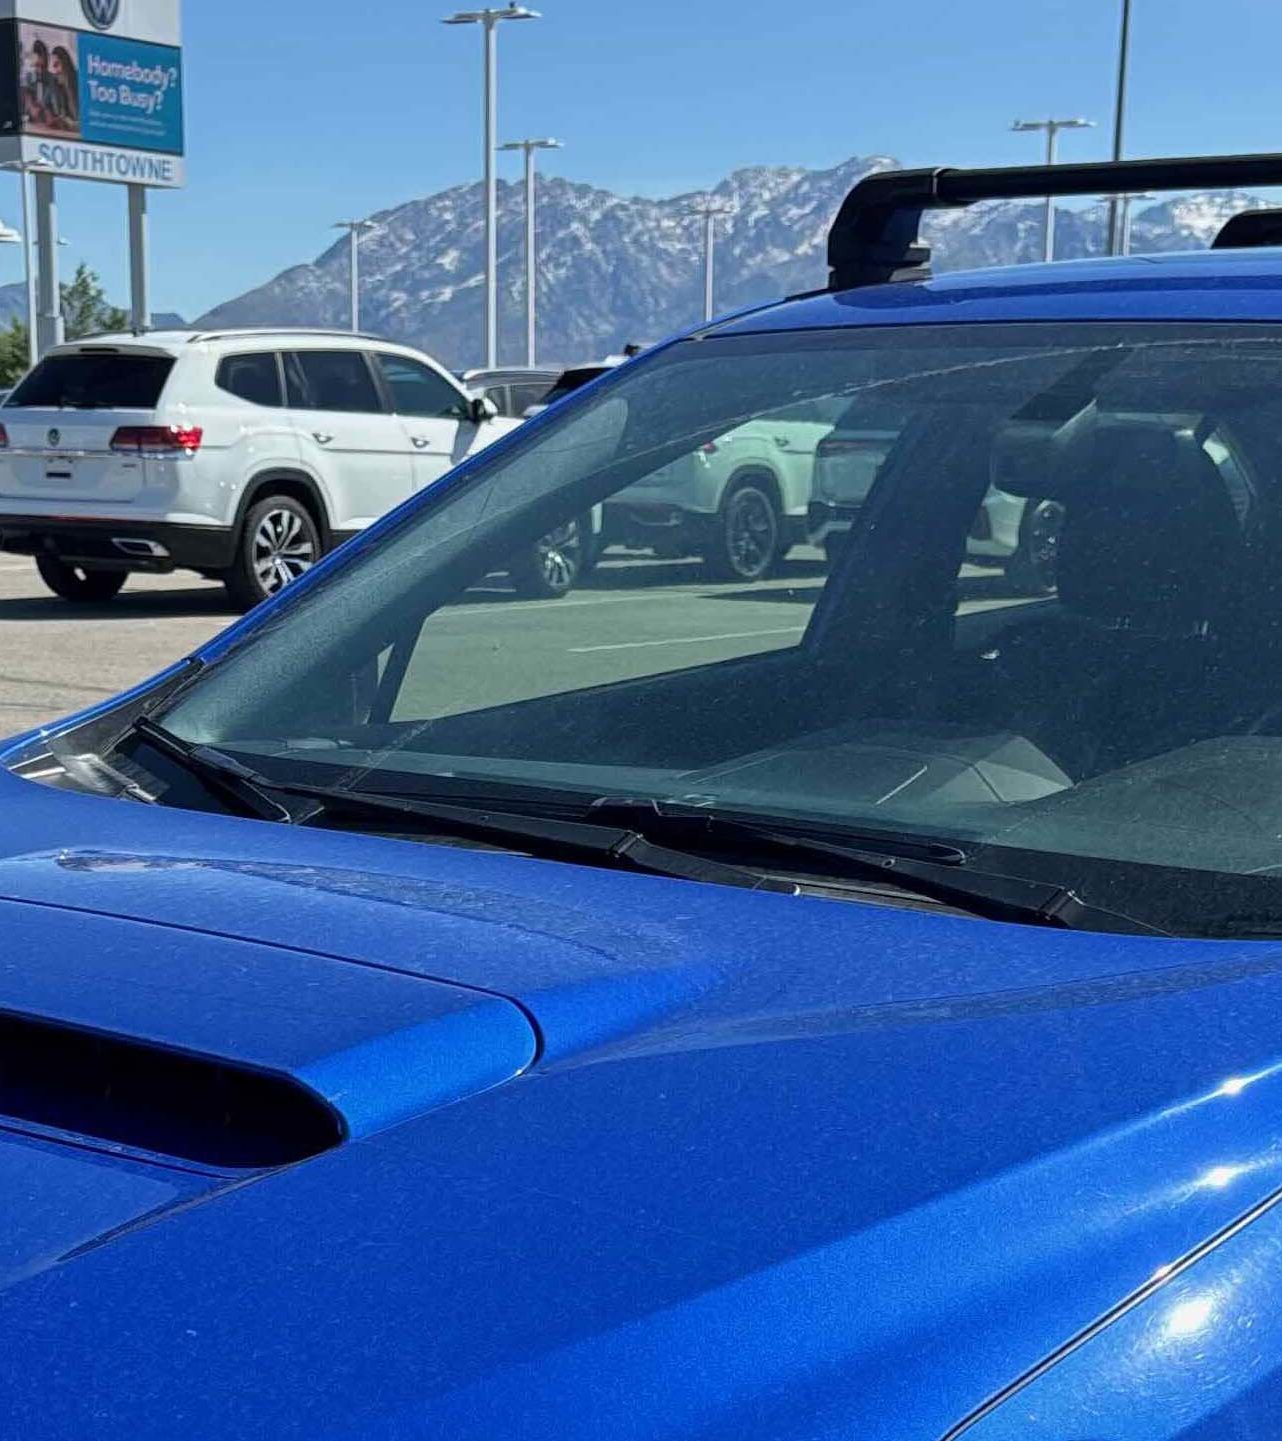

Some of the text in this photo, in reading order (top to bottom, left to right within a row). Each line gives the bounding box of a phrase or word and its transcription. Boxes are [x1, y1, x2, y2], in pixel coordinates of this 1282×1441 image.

[87, 53, 177, 92] Homebody?
[87, 80, 165, 114] Too Busy?
[39, 143, 174, 181] SOUTHTOWNE
